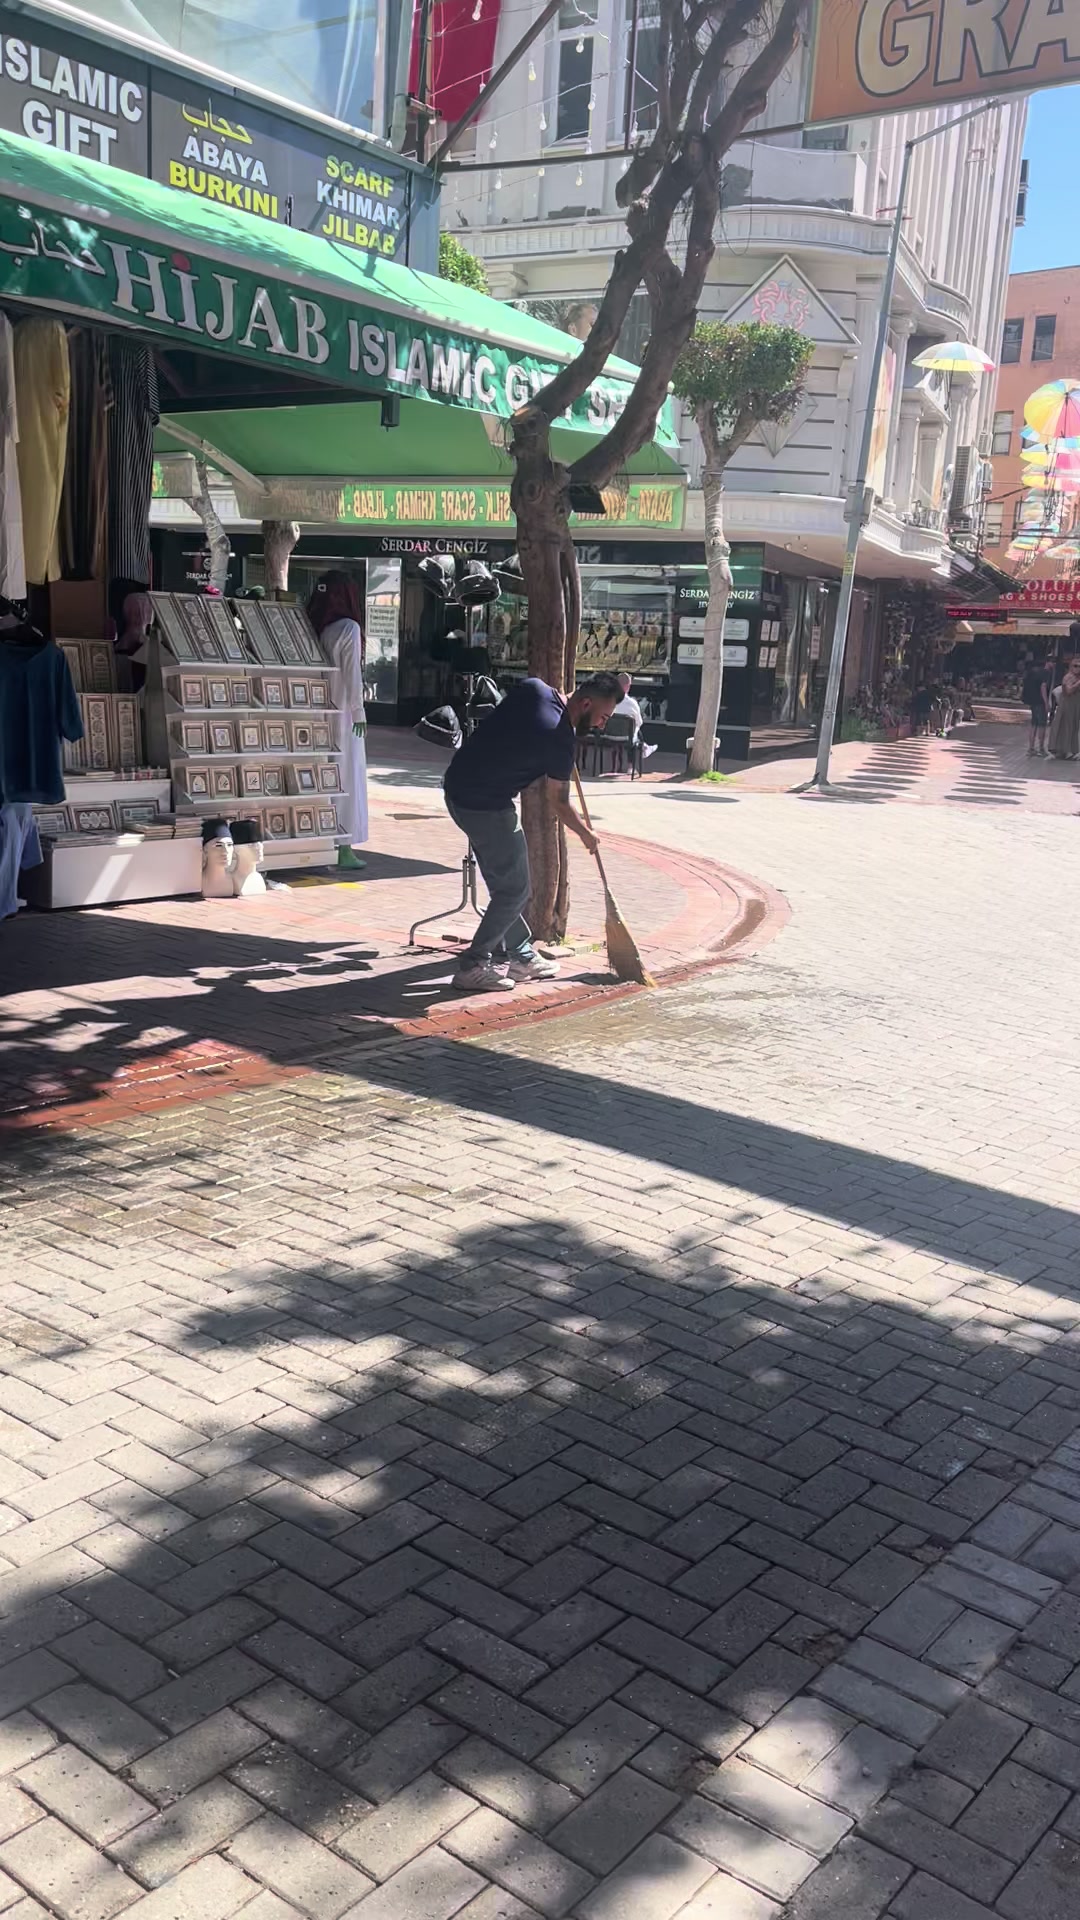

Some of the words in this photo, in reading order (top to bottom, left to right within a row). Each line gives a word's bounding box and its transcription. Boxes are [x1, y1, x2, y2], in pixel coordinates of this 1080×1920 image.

[0, 34, 142, 122] SLAMIC
[23, 100, 117, 165] GIFT
[183, 98, 253, 144] حجاب
[183, 136, 269, 187] ABAYA
[326, 155, 394, 197] SCARF
[170, 161, 278, 219] BURKINI
[317, 180, 400, 231] KHIMAR
[322, 213, 396, 255] JILBAB
[348, 319, 496, 405] ISLAMIC
[381, 537, 432, 553] SERDAR
[680, 588, 709, 598] SERDA
[1031, 592, 1074, 601] SHOES
